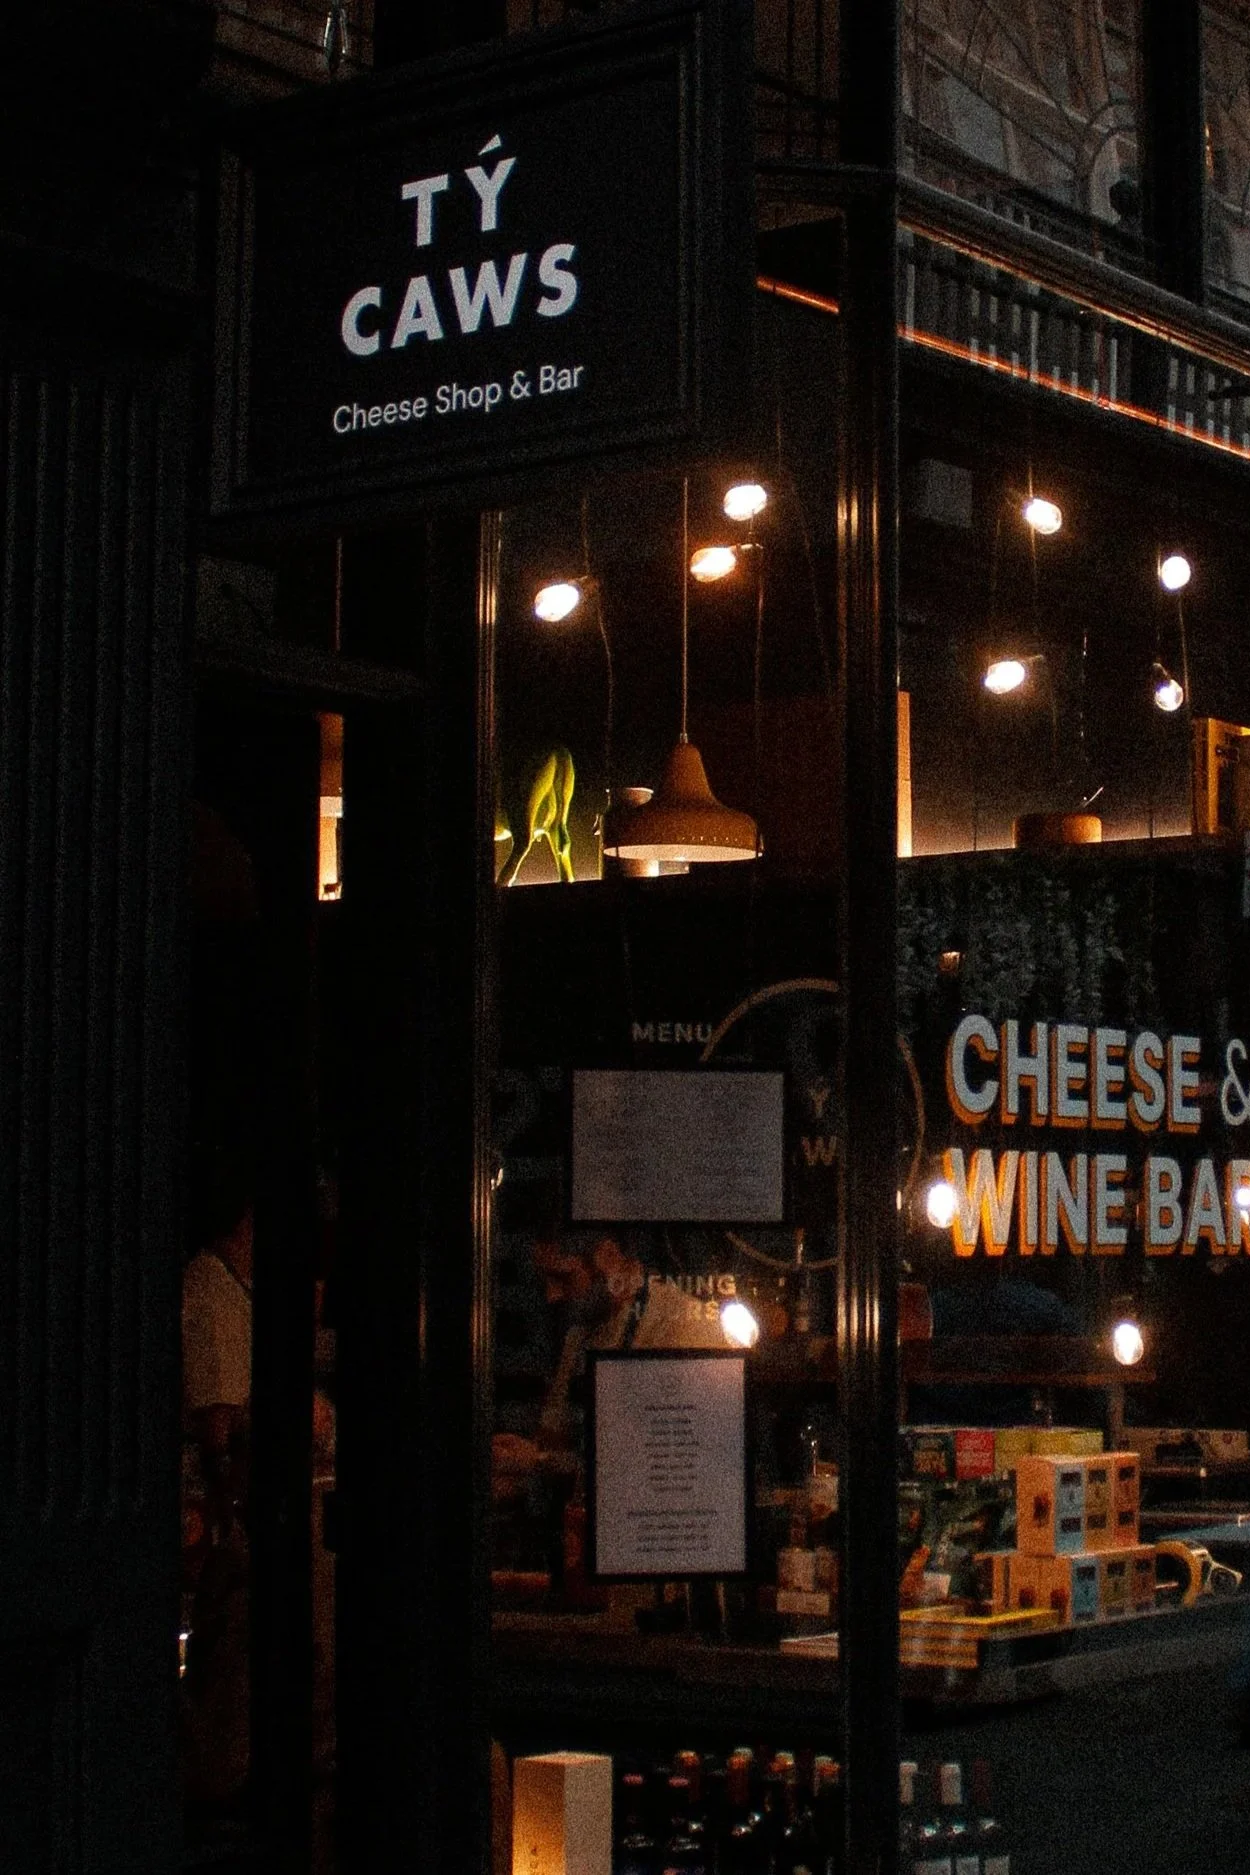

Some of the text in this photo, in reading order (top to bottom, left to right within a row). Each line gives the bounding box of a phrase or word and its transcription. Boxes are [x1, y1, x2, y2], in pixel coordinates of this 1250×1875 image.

[401, 133, 517, 248] TÝ
[341, 243, 579, 356] CAWS
[333, 365, 585, 433] Cheese Shop & Bar
[631, 1021, 713, 1044] MENU
[945, 1014, 1201, 1136] CHEESE
[942, 1147, 1128, 1257] WINE
[626, 1299, 719, 1322] HRS
